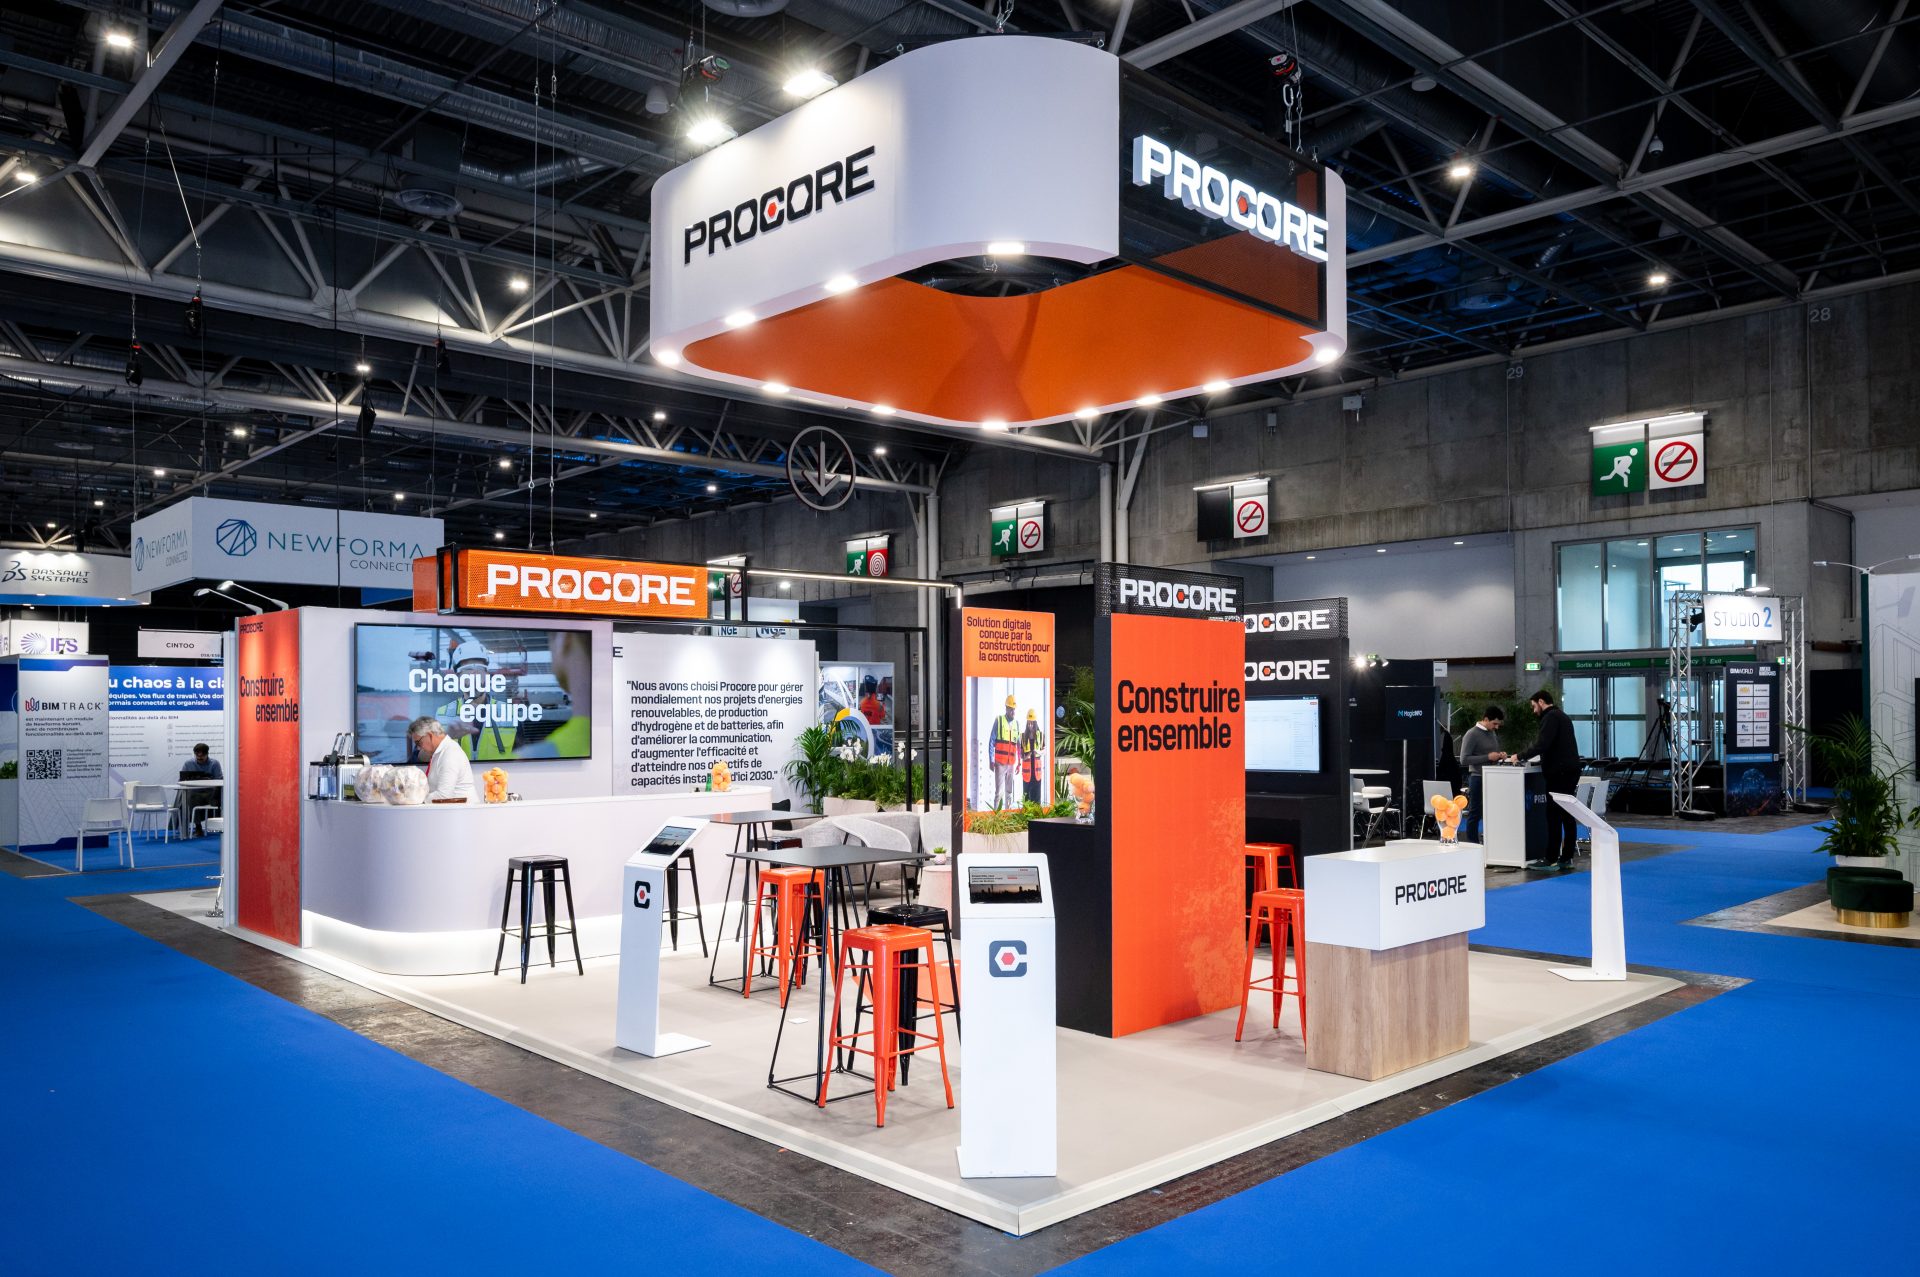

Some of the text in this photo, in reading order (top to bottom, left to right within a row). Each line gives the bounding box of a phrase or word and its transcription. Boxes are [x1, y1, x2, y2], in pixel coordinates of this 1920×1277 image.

[684, 145, 876, 265] PROCORE
[1133, 134, 1328, 263] PROCORE
[1809, 307, 1830, 322] 28
[1508, 366, 1524, 379] 29
[146, 530, 188, 560] NEWFORMA
[268, 532, 424, 558] NEWFORMA
[32, 569, 91, 577] DASSAULT
[350, 560, 414, 572] CONNECT
[487, 564, 696, 606] PROCORE
[1120, 578, 1236, 612] PROCORE
[966, 616, 1031, 631] Solution digitale
[1244, 609, 1330, 634] OCORE
[1714, 606, 1772, 628] STUDIO 2
[720, 626, 738, 636] NGE
[980, 630, 1032, 641] conçue par la
[50, 637, 78, 652] IFS
[979, 641, 1050, 654] construction pour
[979, 651, 1041, 663] la construction.
[1244, 660, 1330, 682] OCORE
[109, 679, 118, 688] u
[123, 677, 172, 688] chaos
[176, 677, 185, 688] à
[190, 677, 203, 688] la
[240, 672, 284, 697] Construire
[408, 668, 506, 696] Chaque
[626, 680, 804, 693] "Nous avons choisi Procore pour gérer
[631, 694, 802, 706] mondialement nos projets d'energies
[1118, 680, 1240, 714] Construire
[256, 698, 298, 722] ensemble
[460, 699, 544, 726] équipe
[631, 708, 768, 719] renouvelables, de production
[631, 720, 784, 734] d'hydrogène et de batteries, afin
[1118, 716, 1231, 752] ensemble
[631, 733, 773, 745] d'améliorer la communication,
[631, 746, 758, 760] d'augmenter l'efficacité et
[631, 758, 762, 772] d'atteindre nos octifs de
[631, 774, 681, 787] capacités
[731, 772, 748, 782] d'ici
[749, 771, 778, 781] 2030."
[1396, 874, 1467, 905] PROCORE
